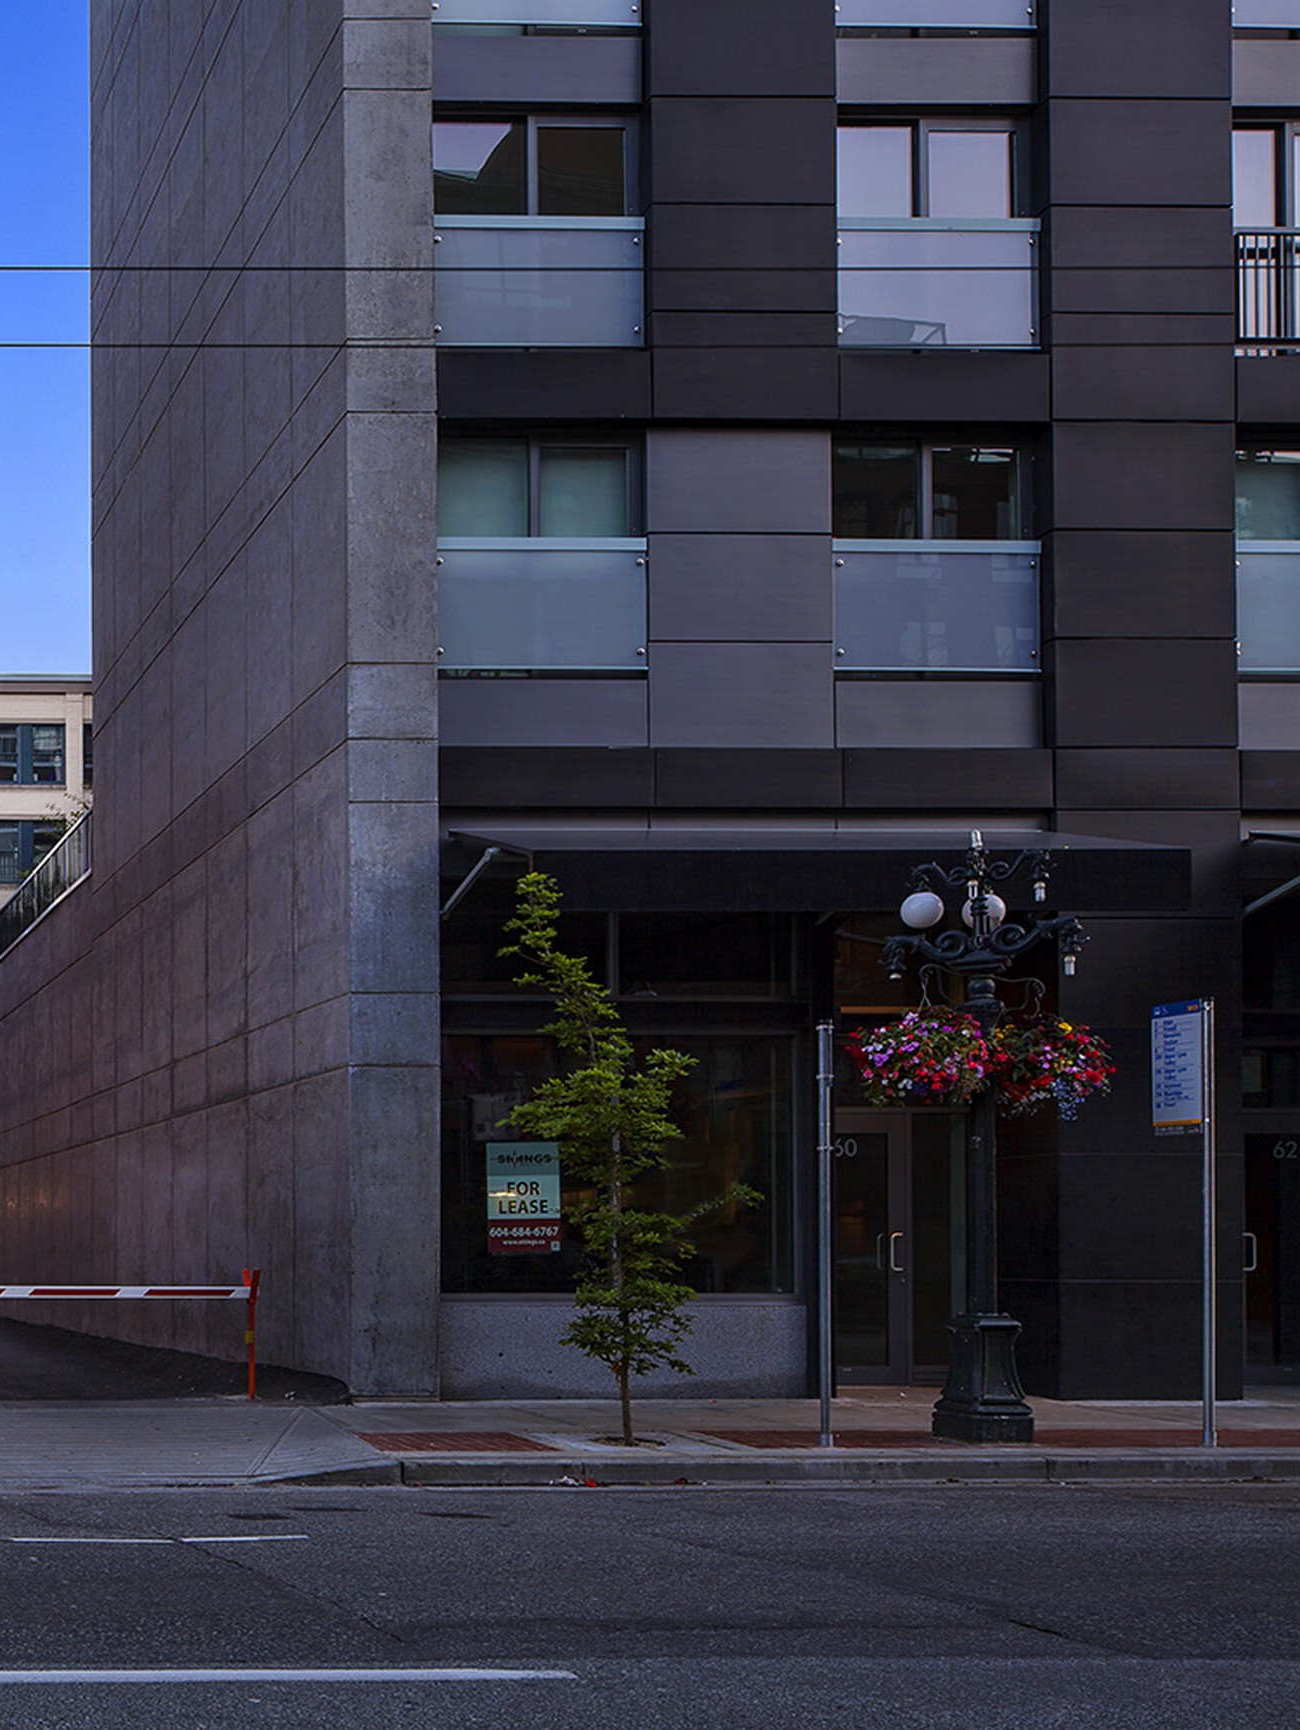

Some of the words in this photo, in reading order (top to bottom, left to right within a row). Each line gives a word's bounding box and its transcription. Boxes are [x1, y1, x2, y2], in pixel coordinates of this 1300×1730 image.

[1272, 1140, 1298, 1159] 62
[507, 1182, 540, 1196] FOR
[499, 1200, 549, 1214] LEASE
[489, 1226, 559, 1237] 604-684-6767
